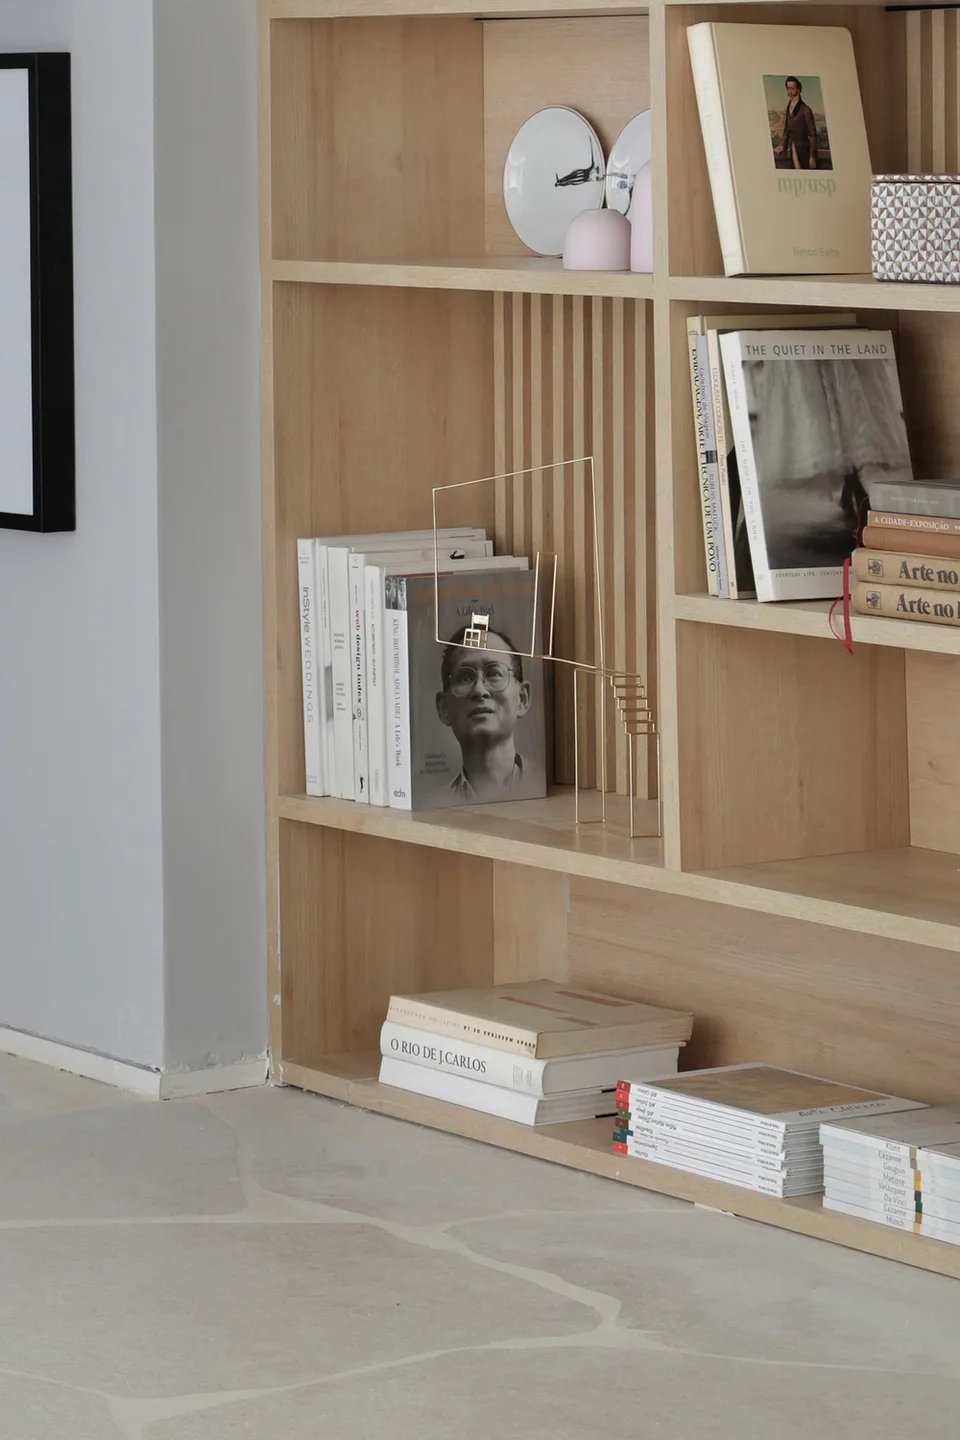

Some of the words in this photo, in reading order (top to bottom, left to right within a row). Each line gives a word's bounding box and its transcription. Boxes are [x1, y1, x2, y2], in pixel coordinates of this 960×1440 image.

[777, 176, 837, 197] mp/usp
[792, 247, 818, 257] Banco
[745, 344, 767, 355] THE
[773, 344, 806, 356] QUIET
[813, 344, 825, 355] IN
[830, 344, 851, 355] THE
[857, 343, 888, 355] LAND
[712, 367, 721, 403] ELOQUENT
[703, 403, 708, 412] de
[714, 403, 724, 443] CONCRETE
[704, 503, 712, 517] DE
[706, 520, 714, 542] UM
[880, 517, 950, 531] CIDADE-EXPOSIÇÃO
[707, 542, 717, 573] POVO
[899, 560, 934, 582] Arte
[937, 569, 959, 585] no
[302, 586, 311, 633] InStyle
[896, 593, 931, 615] Arte
[933, 602, 955, 618] no
[392, 618, 400, 637] KING
[304, 636, 314, 724] WEDDINGS
[483, 1031, 514, 1042] MAESTRAS
[516, 1039, 536, 1049] OBRAS
[390, 1037, 399, 1051] O
[401, 1040, 421, 1057] RIO
[423, 1045, 437, 1061] DE
[438, 1050, 487, 1074] J.CARLOS
[885, 1142, 902, 1151] Klimt
[882, 1162, 906, 1175] Gauguin
[883, 1173, 905, 1186] Matisse
[883, 1193, 892, 1203] Da
[892, 1195, 907, 1206] Vinci
[886, 1215, 905, 1227] Munch
